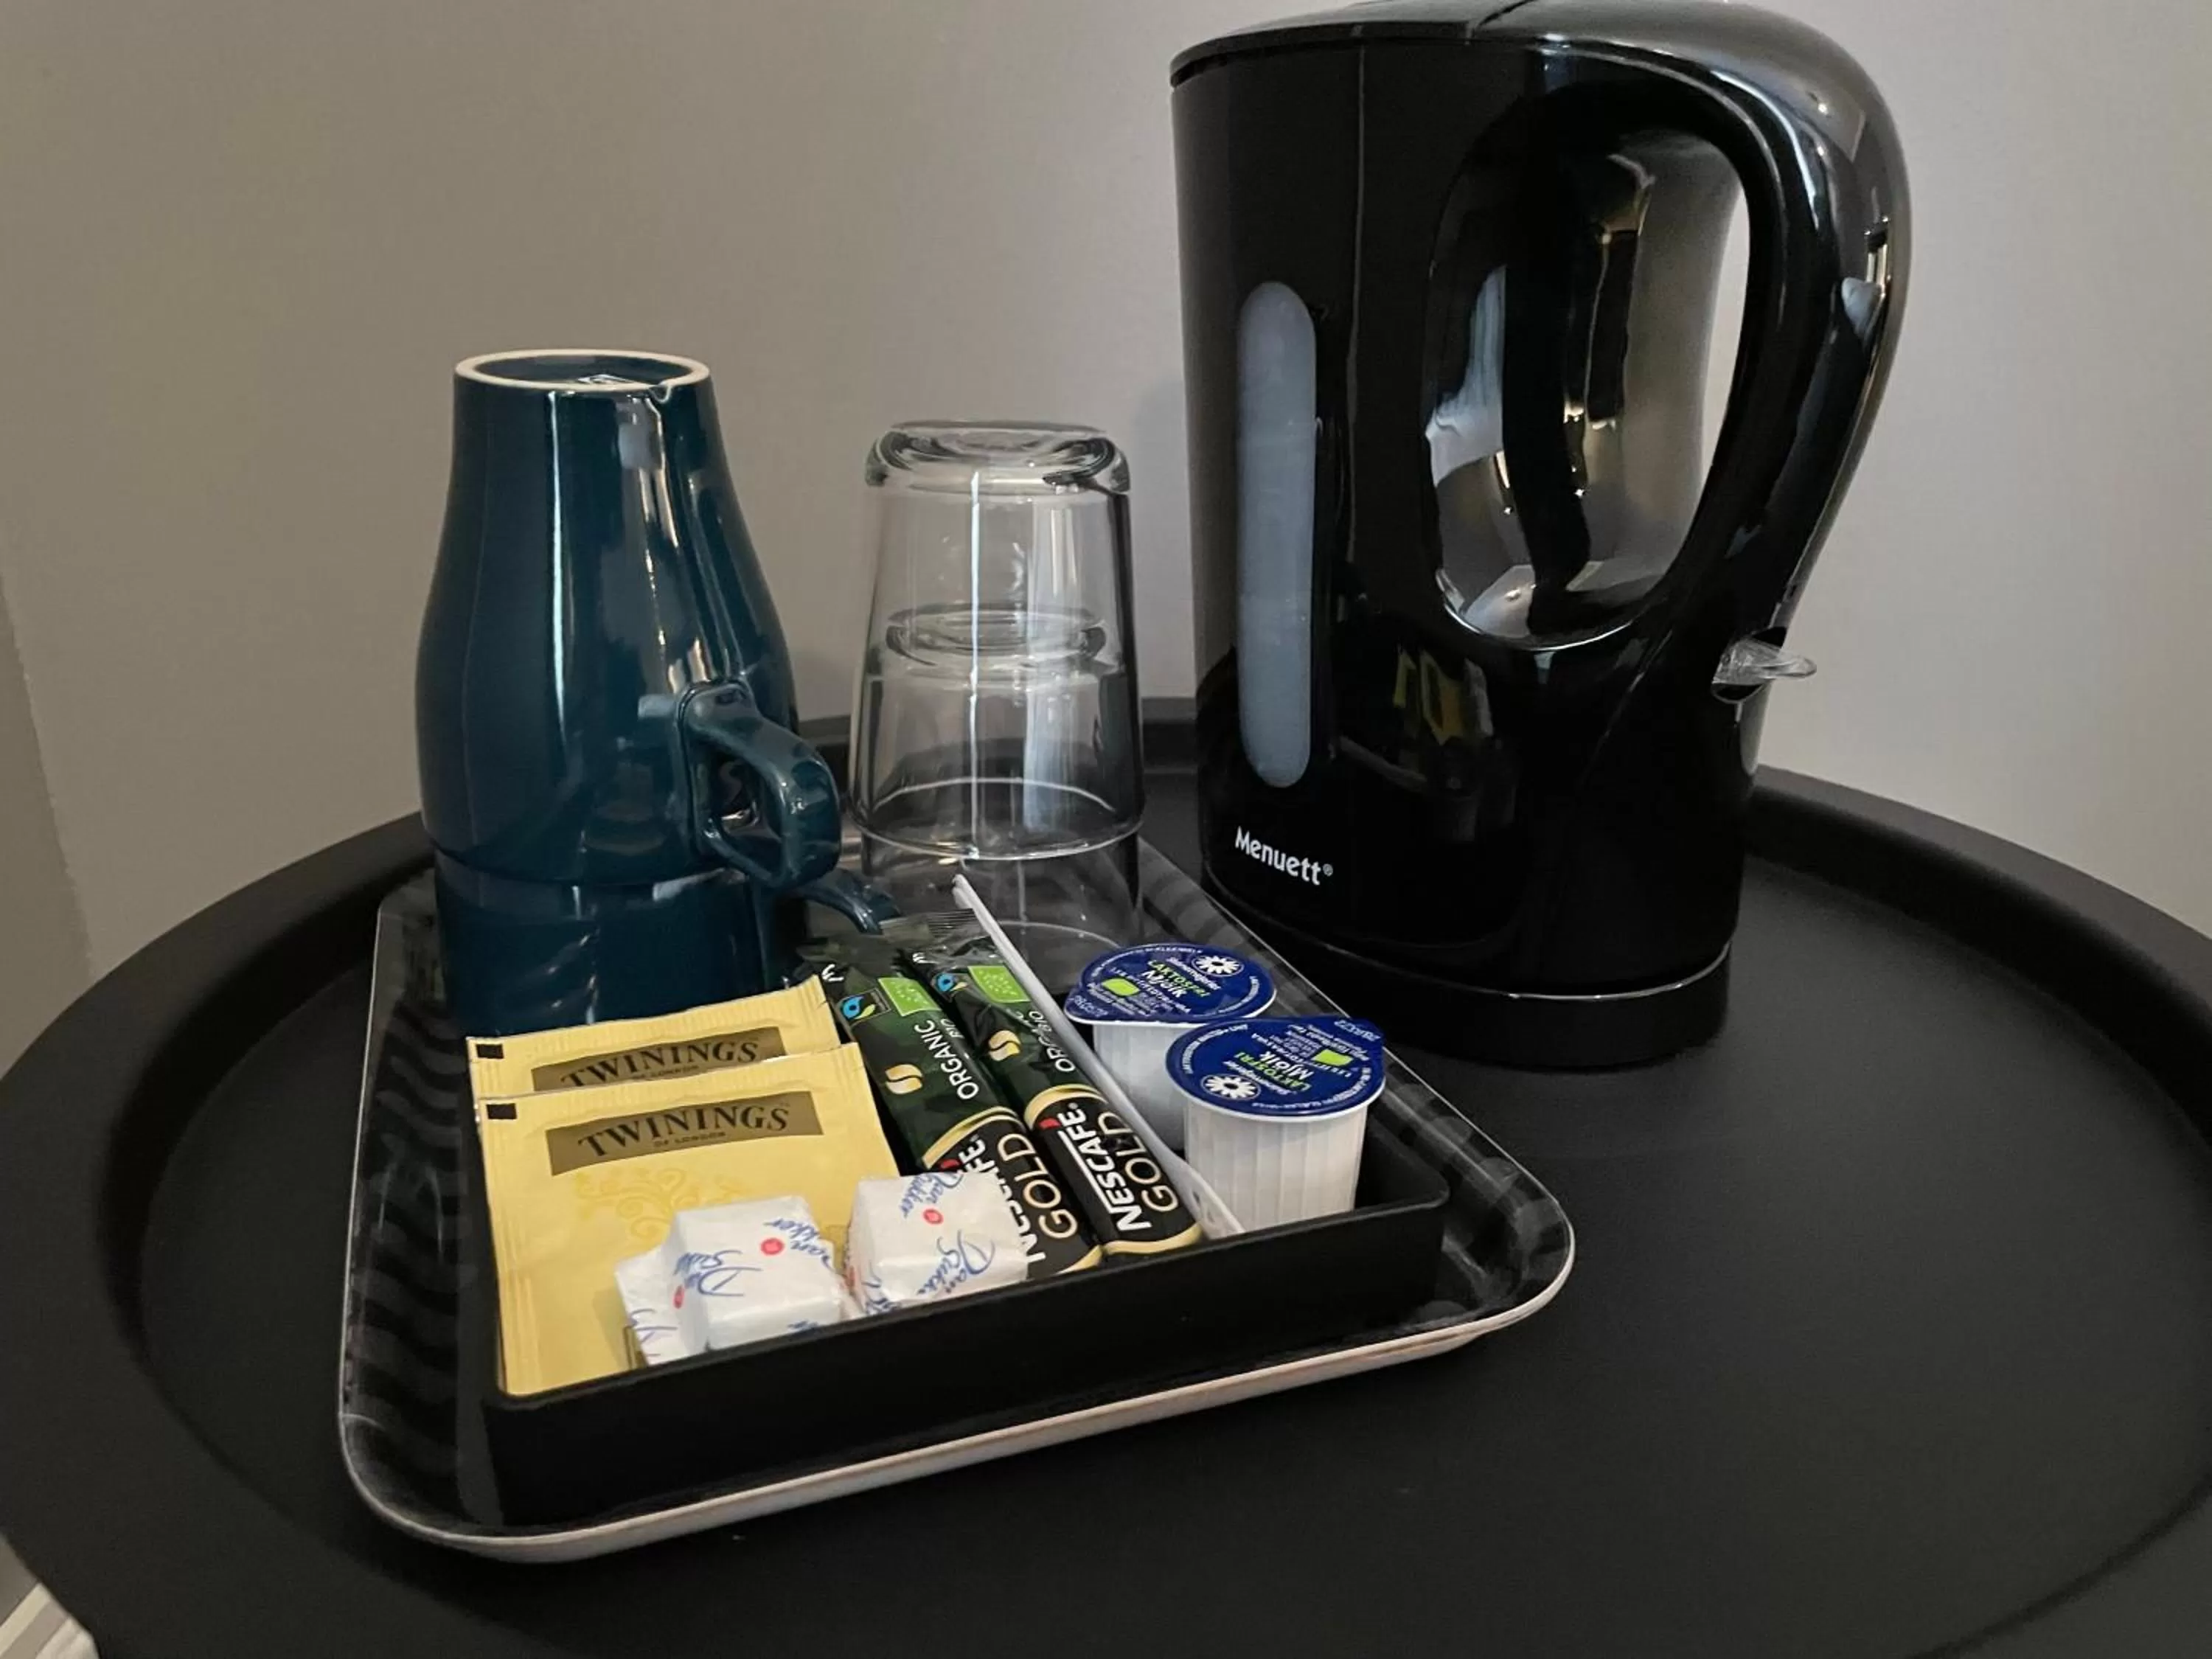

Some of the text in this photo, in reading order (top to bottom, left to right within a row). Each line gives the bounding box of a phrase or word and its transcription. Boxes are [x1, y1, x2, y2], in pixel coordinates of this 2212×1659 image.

[560, 1040, 759, 1088] TWININGS
[914, 1020, 979, 1099] ORGANIC
[1234, 1052, 1312, 1092] LAKTOSFRI
[578, 1105, 790, 1157] TWININGS
[1039, 1108, 1152, 1231] NESCAFÉ
[1098, 1111, 1179, 1212] GOLD
[998, 1133, 1078, 1239] GOLD
